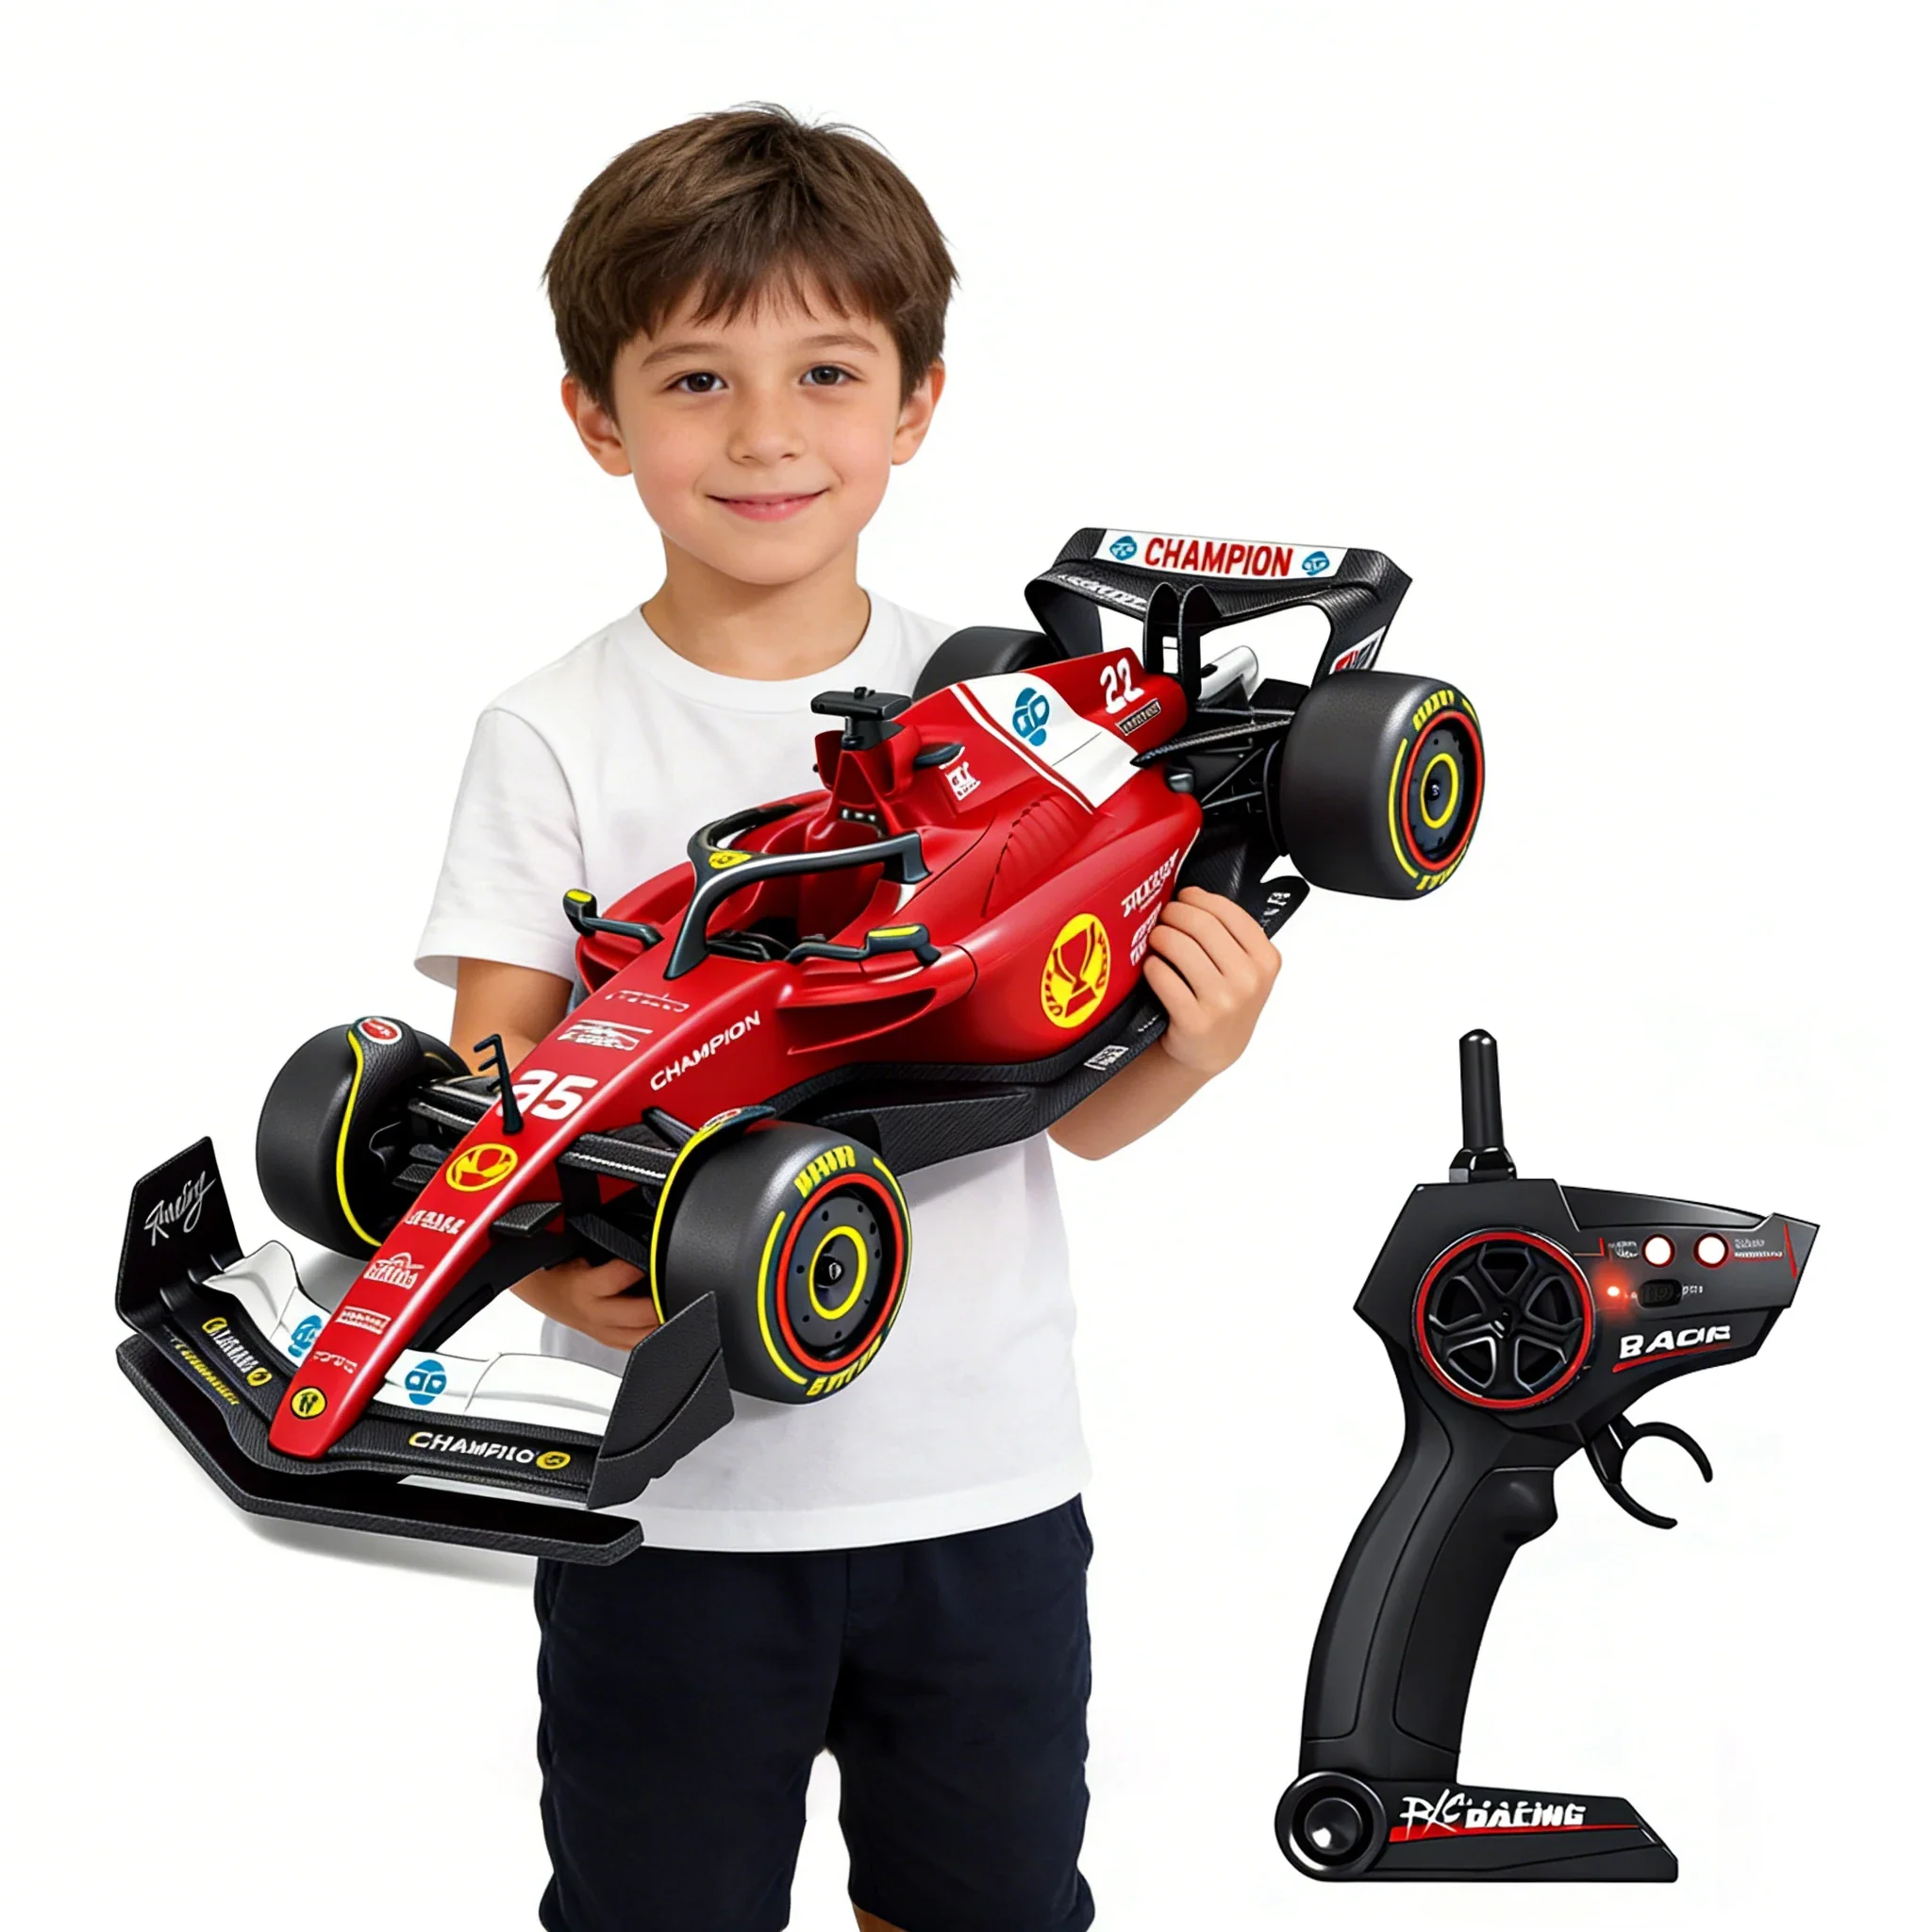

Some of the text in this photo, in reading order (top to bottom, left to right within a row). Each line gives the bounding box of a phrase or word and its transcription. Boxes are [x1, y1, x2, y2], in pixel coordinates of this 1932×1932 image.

[1143, 537, 1293, 577] CHAMPION
[1100, 658, 1144, 714] 22
[650, 1010, 761, 1091] CHAMPION
